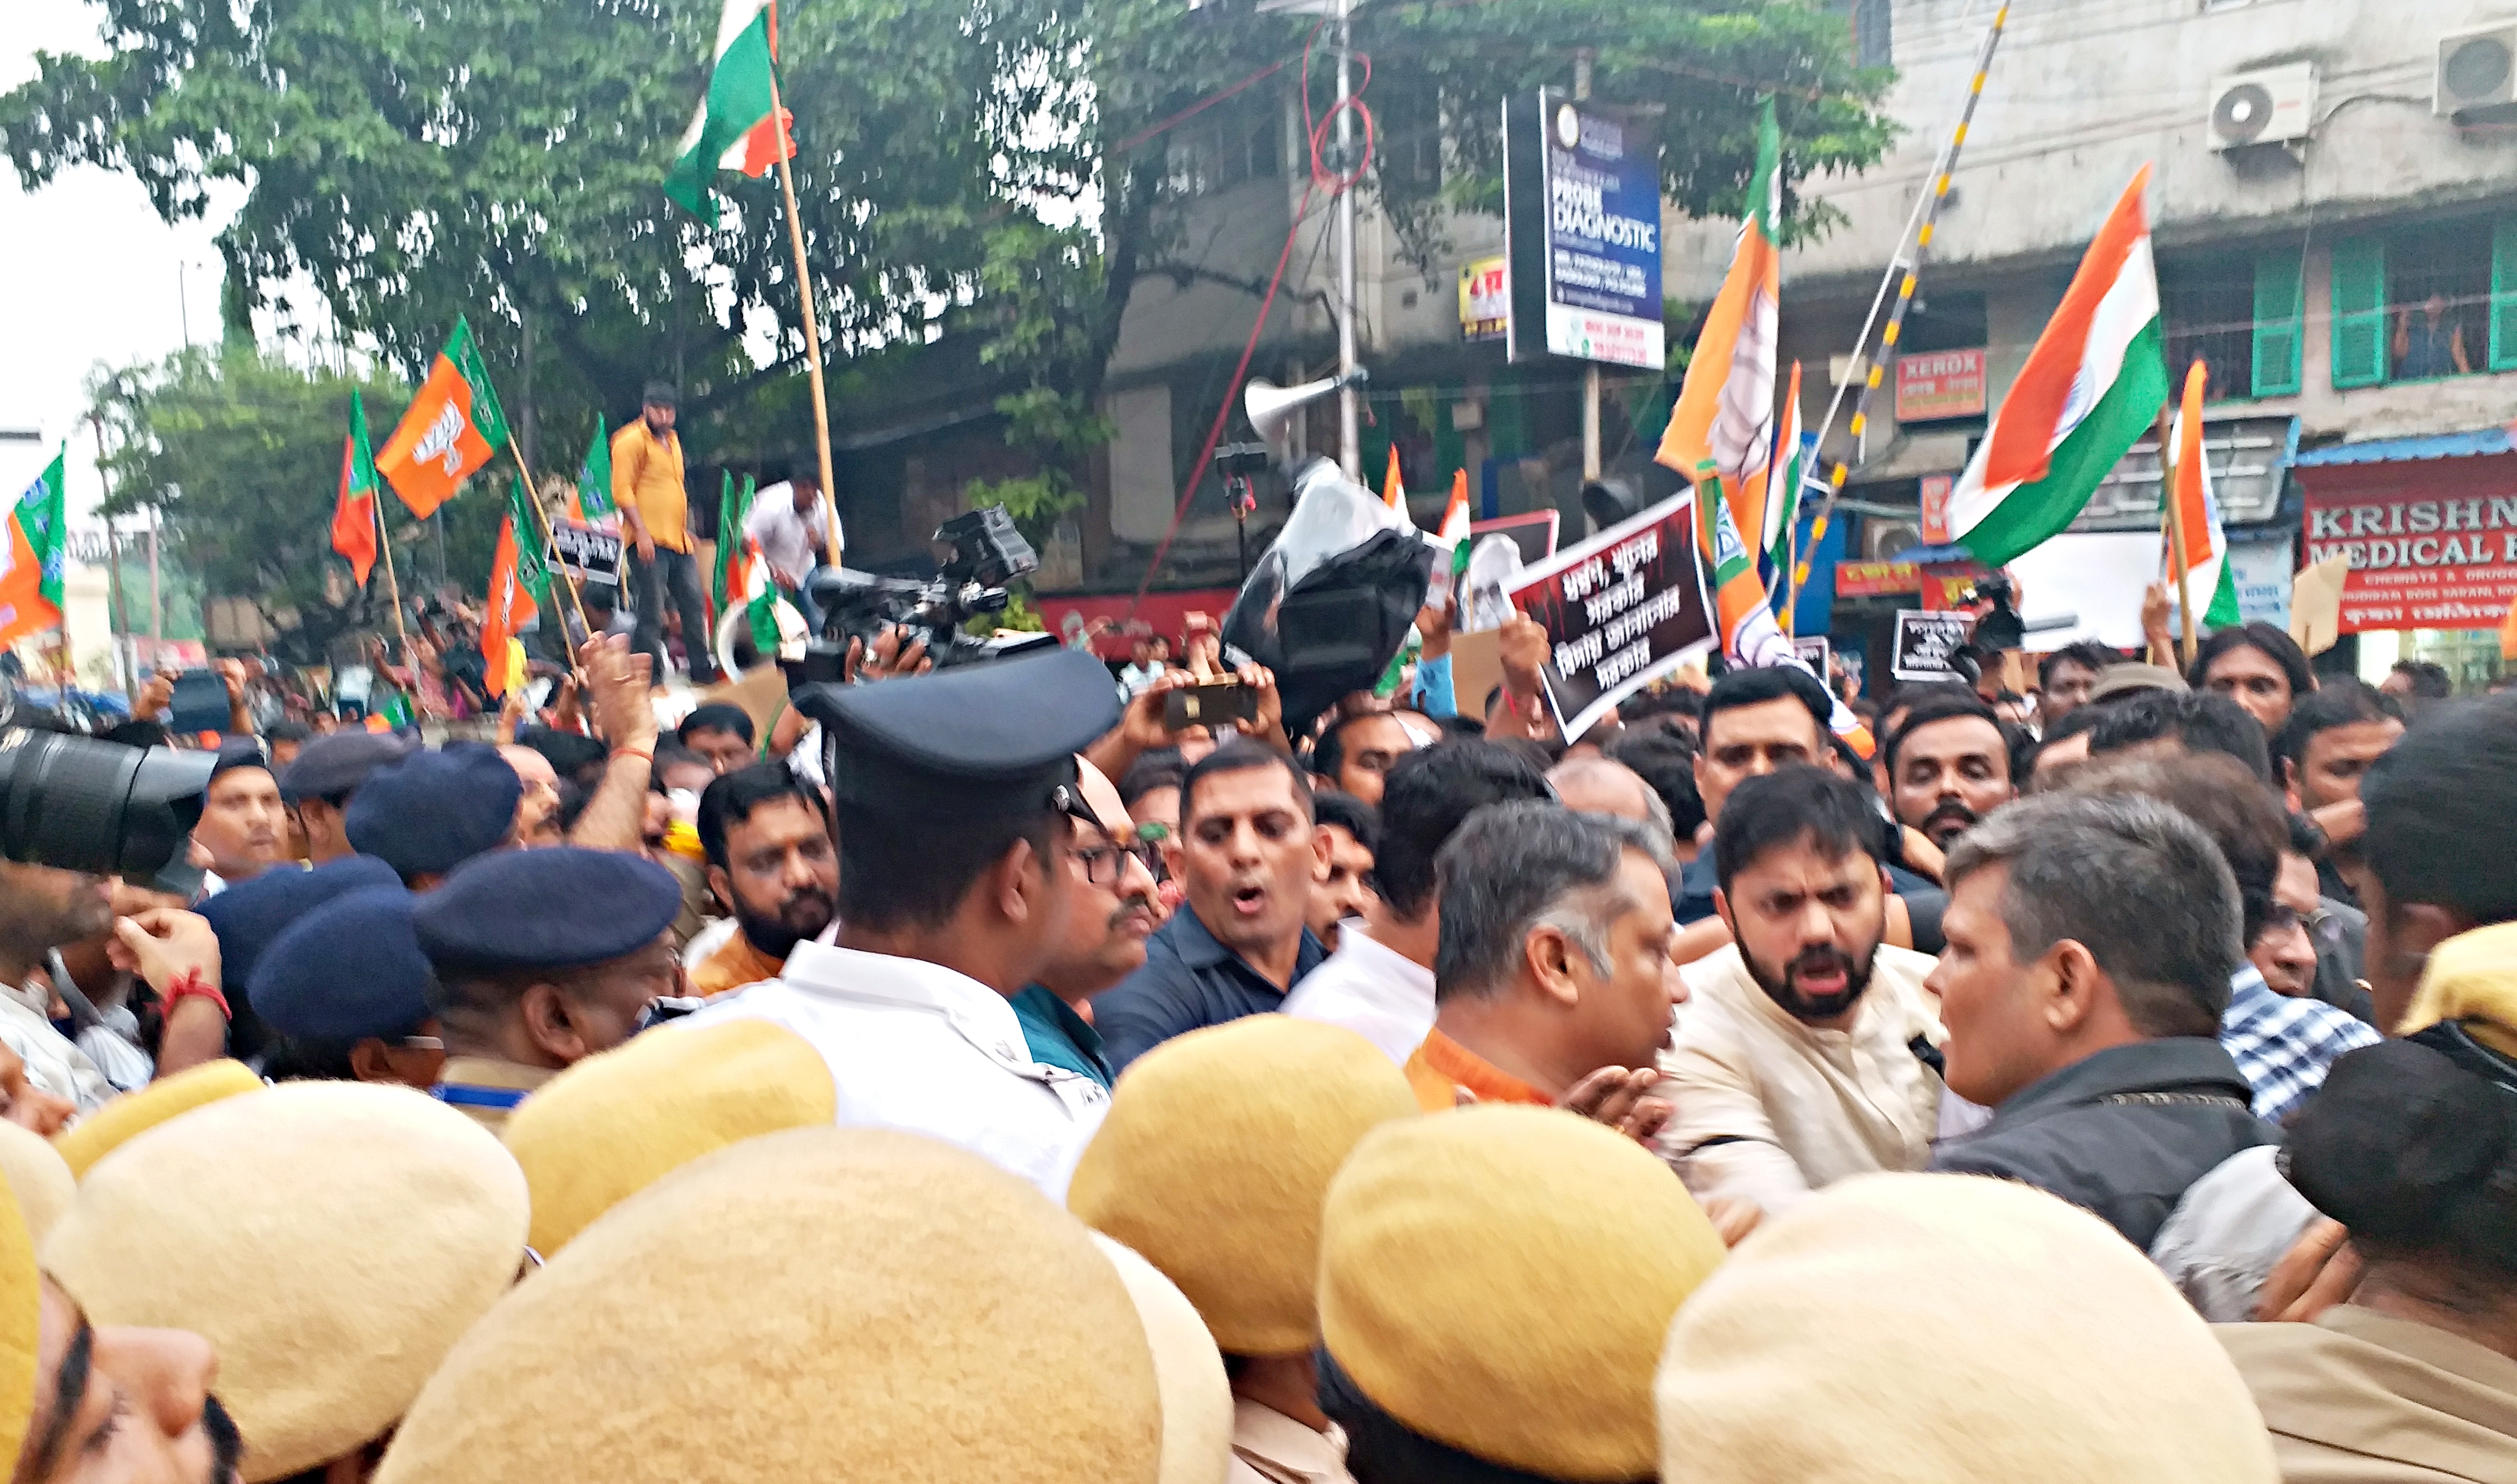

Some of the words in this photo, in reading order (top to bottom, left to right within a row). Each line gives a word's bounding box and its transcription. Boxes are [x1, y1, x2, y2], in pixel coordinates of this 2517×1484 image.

[1553, 204, 1656, 253] DIAGNOSTIC
[1906, 353, 1977, 379] XEROX
[2311, 496, 2517, 540] KRISHN
[2309, 534, 2494, 569] MEDICAL
[1584, 571, 1644, 626] সরকার
